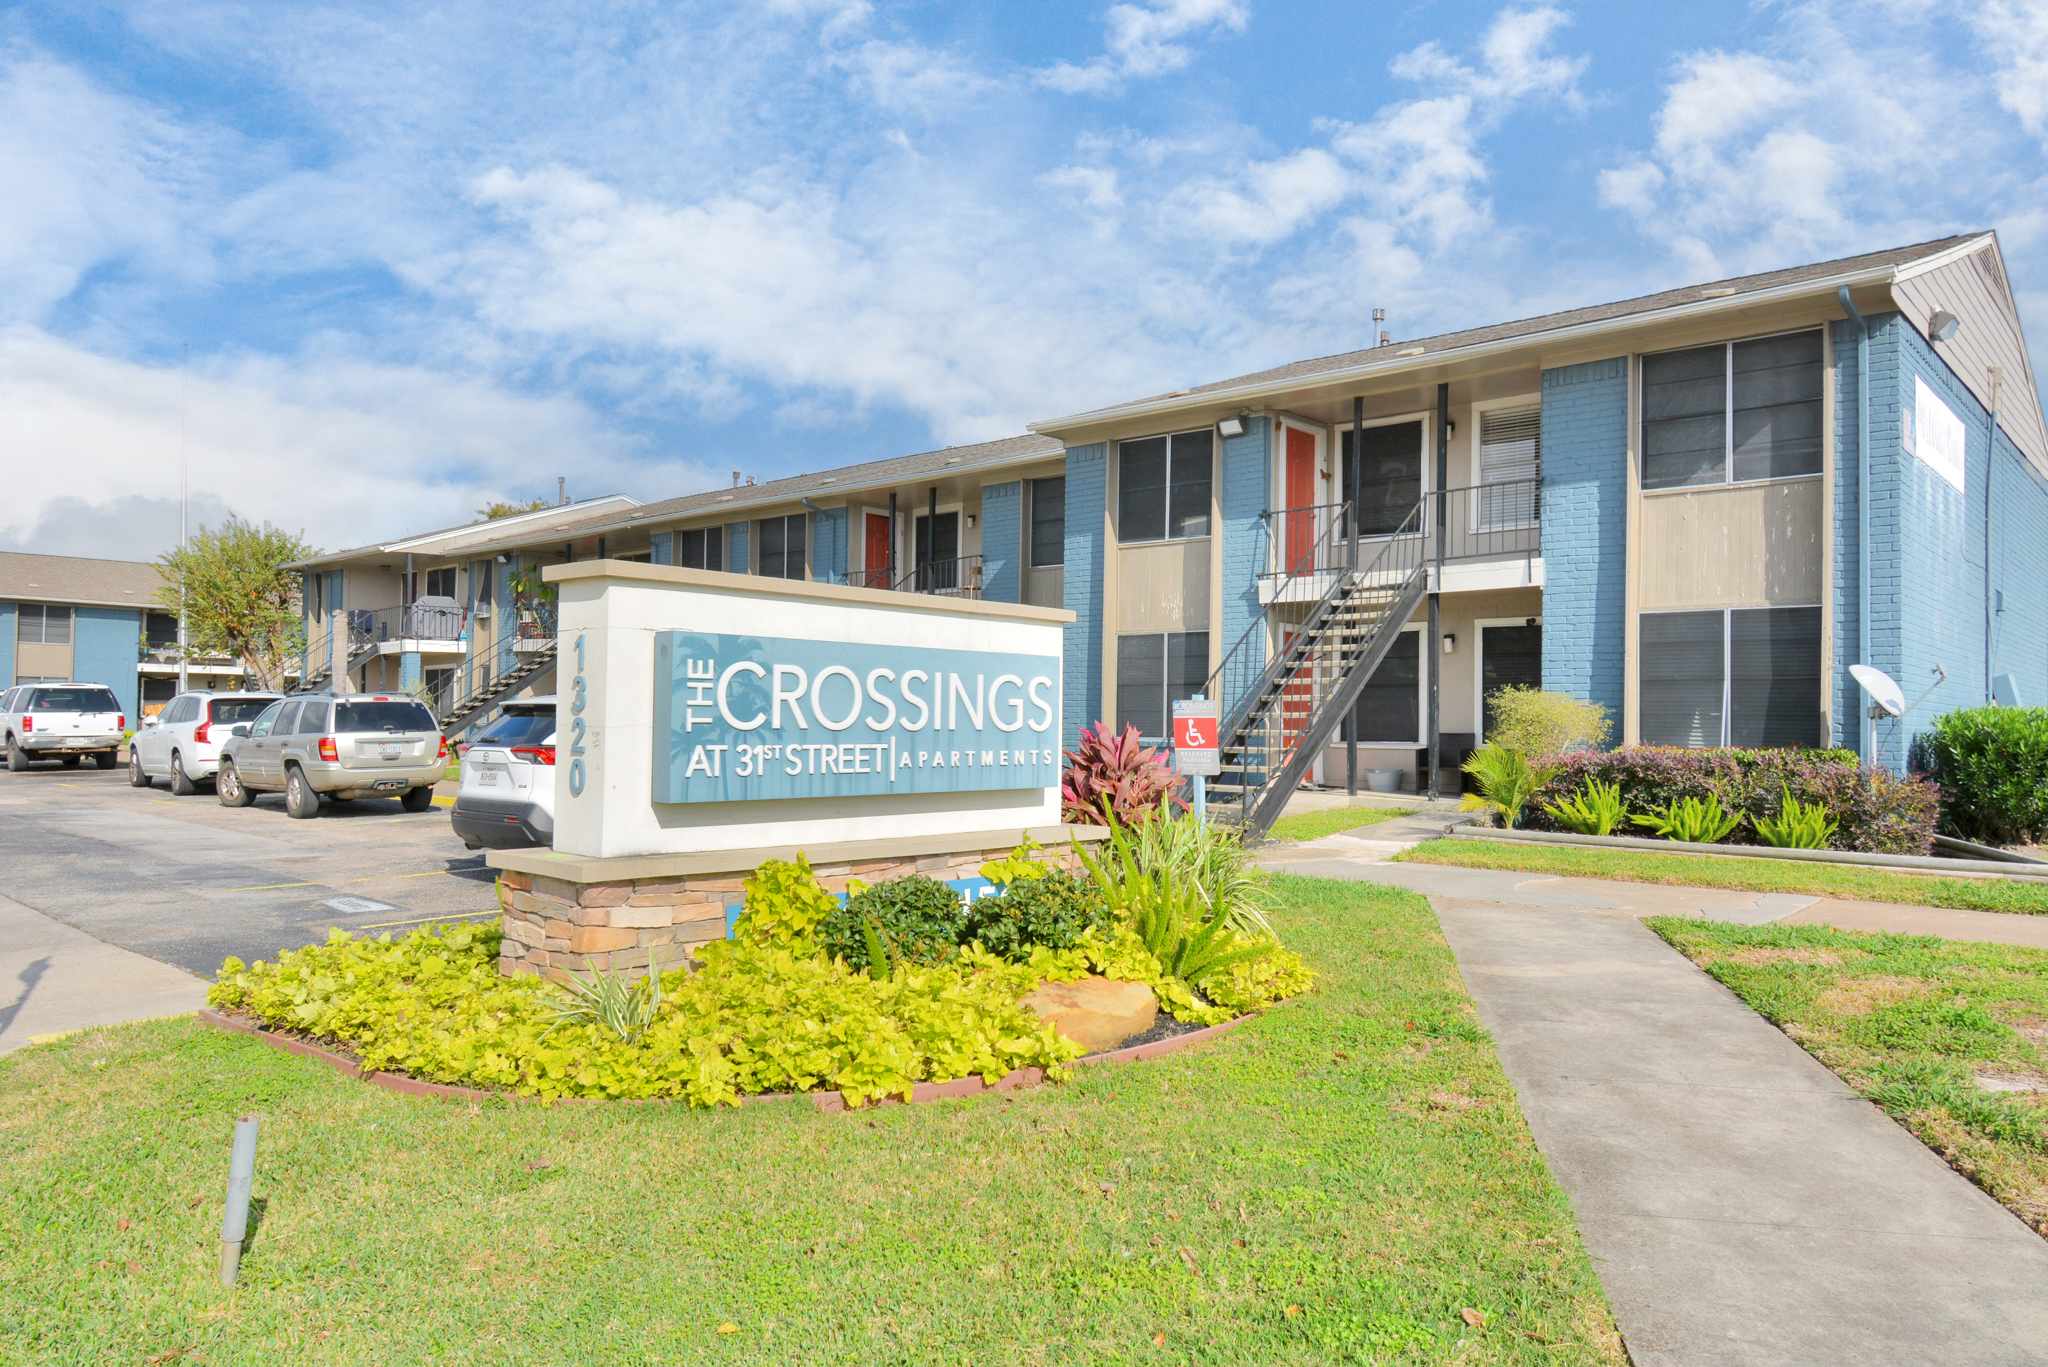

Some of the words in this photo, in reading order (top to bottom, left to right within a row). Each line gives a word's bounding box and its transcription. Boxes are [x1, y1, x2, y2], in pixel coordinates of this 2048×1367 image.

[570, 634, 587, 795] 1320
[685, 658, 715, 733] THE
[716, 660, 1053, 733] CROSSINGS
[1177, 702, 1214, 710] CROSSINGS
[684, 744, 729, 778] AT
[784, 743, 888, 776] STREET
[898, 749, 1053, 769] APARTMENTS
